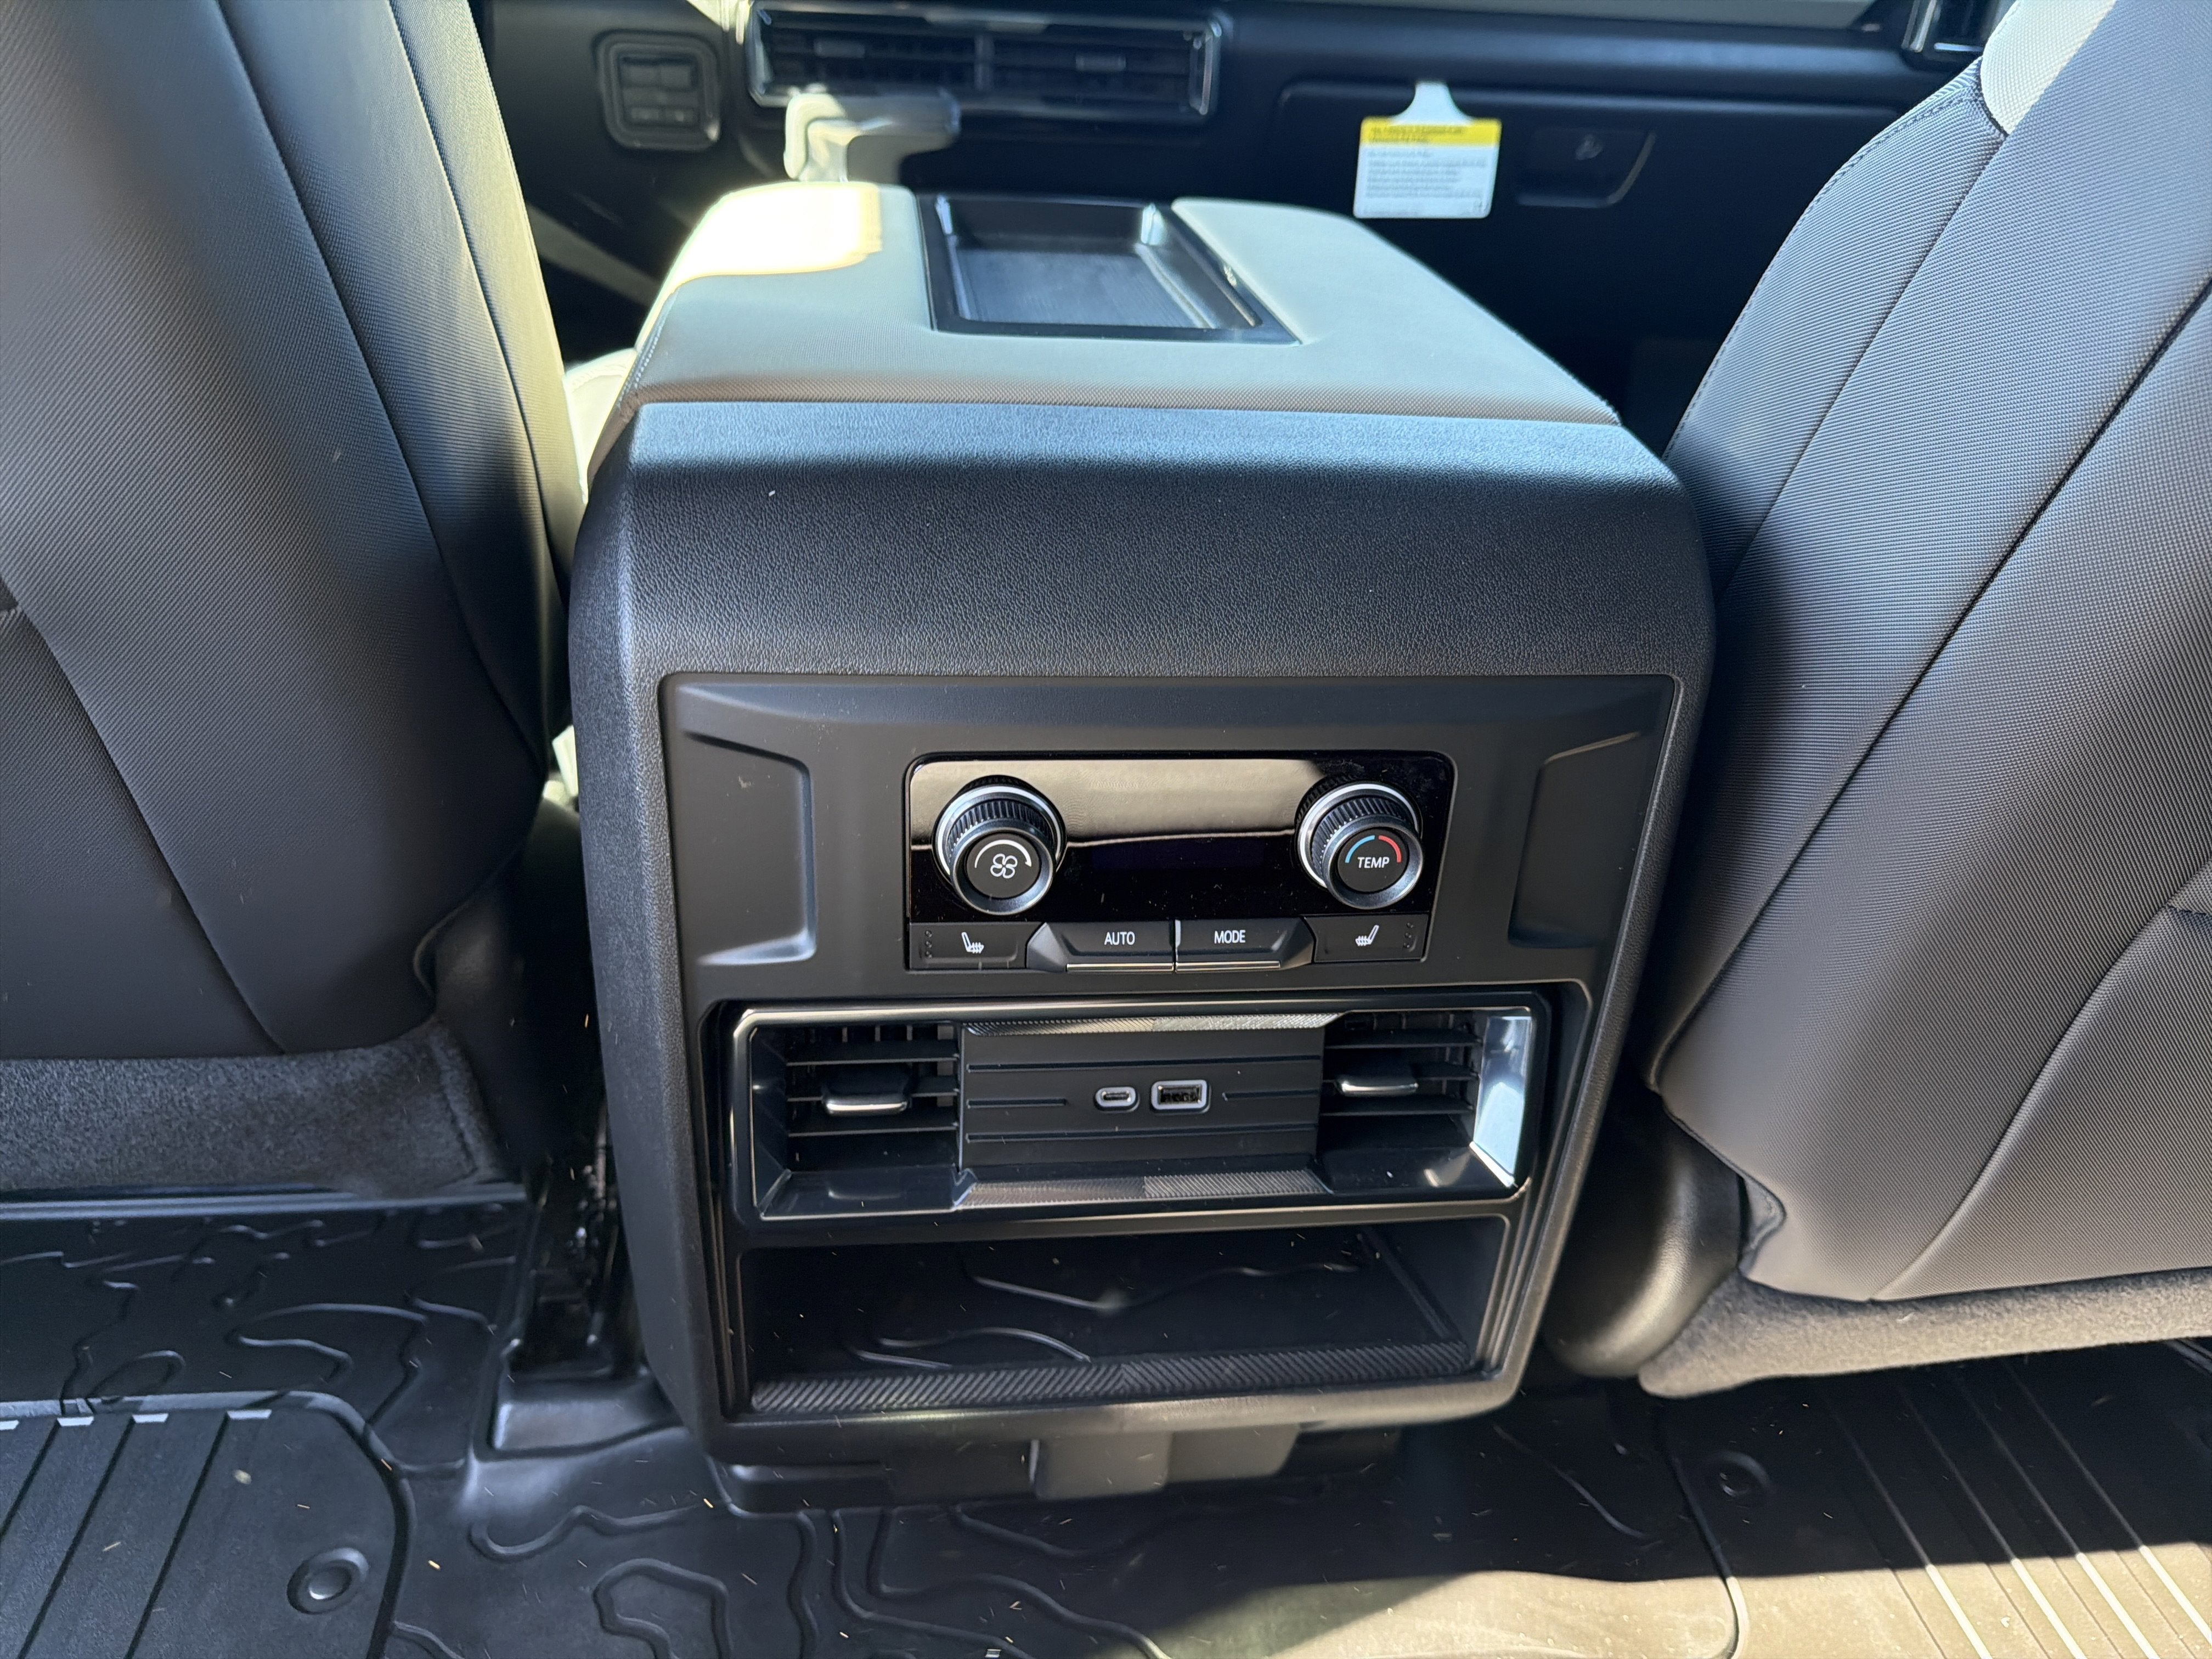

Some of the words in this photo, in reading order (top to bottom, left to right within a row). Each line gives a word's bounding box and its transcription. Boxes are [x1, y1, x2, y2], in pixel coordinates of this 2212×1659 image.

[1357, 856, 1390, 868] TEMP
[1104, 932, 1136, 945] AUTO
[1214, 929, 1246, 944] MODE
